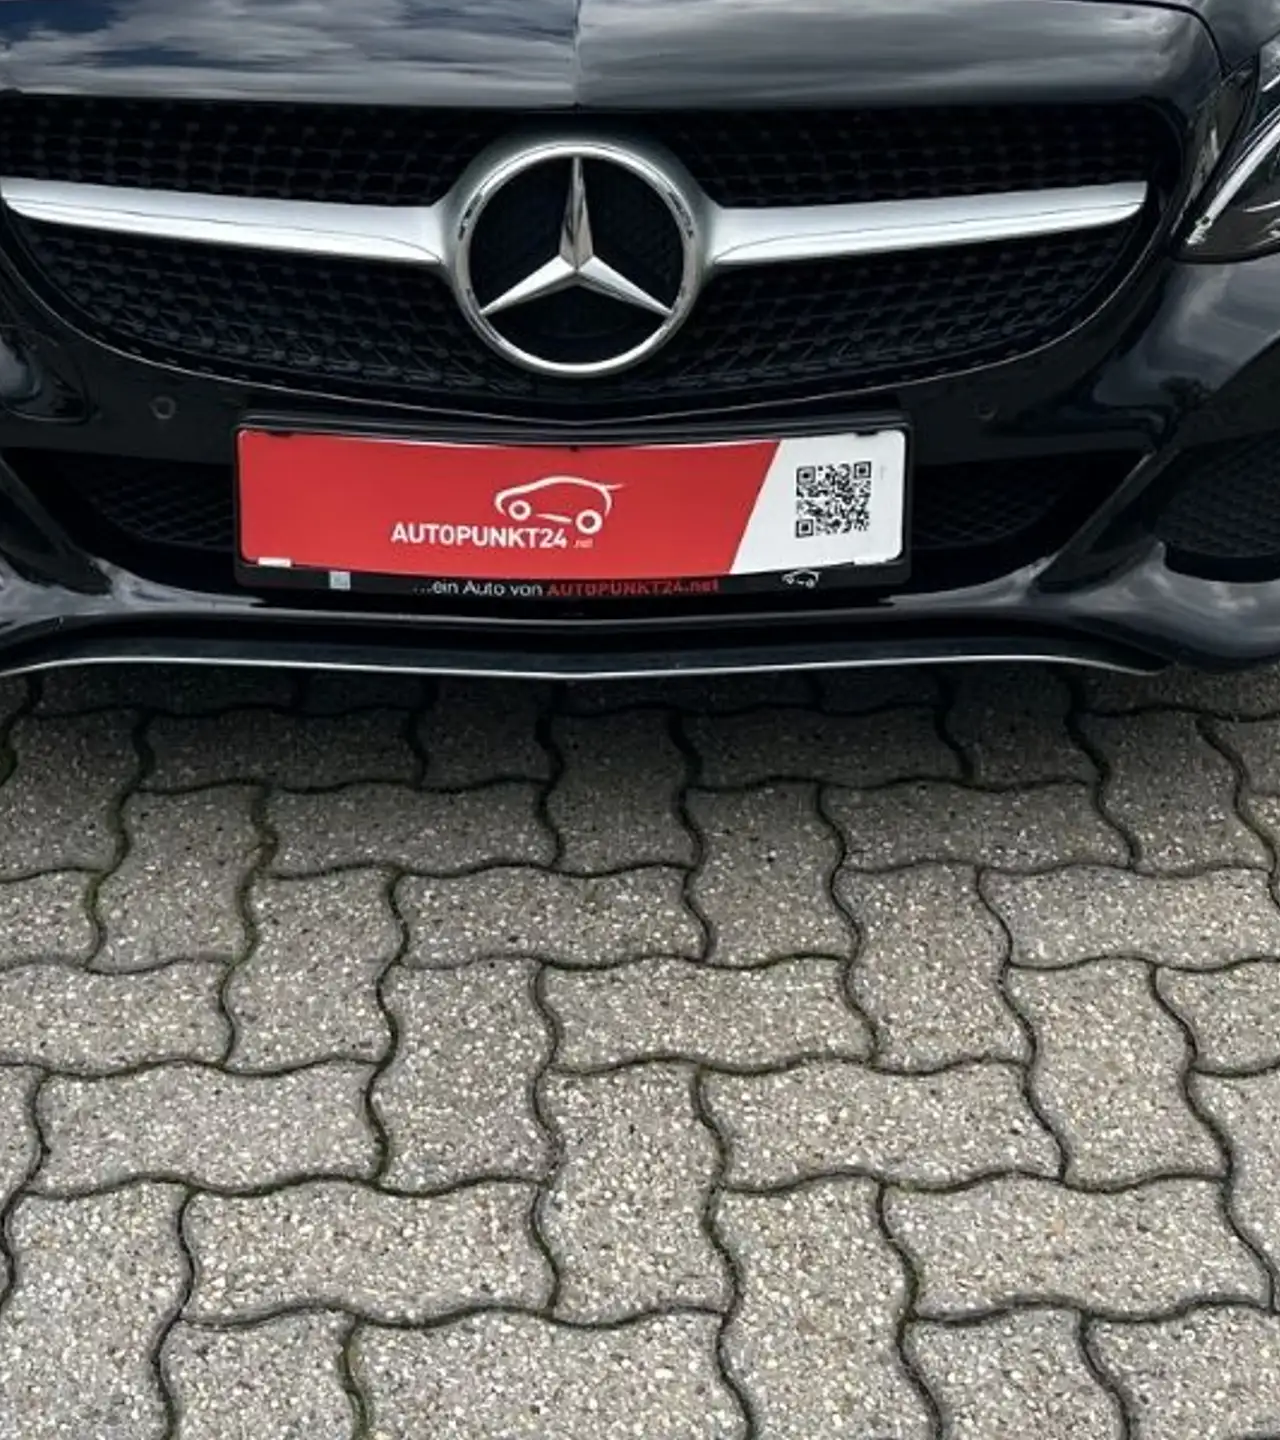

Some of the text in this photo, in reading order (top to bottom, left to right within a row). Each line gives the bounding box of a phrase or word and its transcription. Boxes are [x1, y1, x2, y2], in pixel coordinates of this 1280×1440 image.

[391, 522, 567, 548] AUTOPUNKT24
[462, 580, 505, 596] Auto
[510, 585, 543, 596] von
[546, 579, 720, 596] AUTOPUNKT24.net
